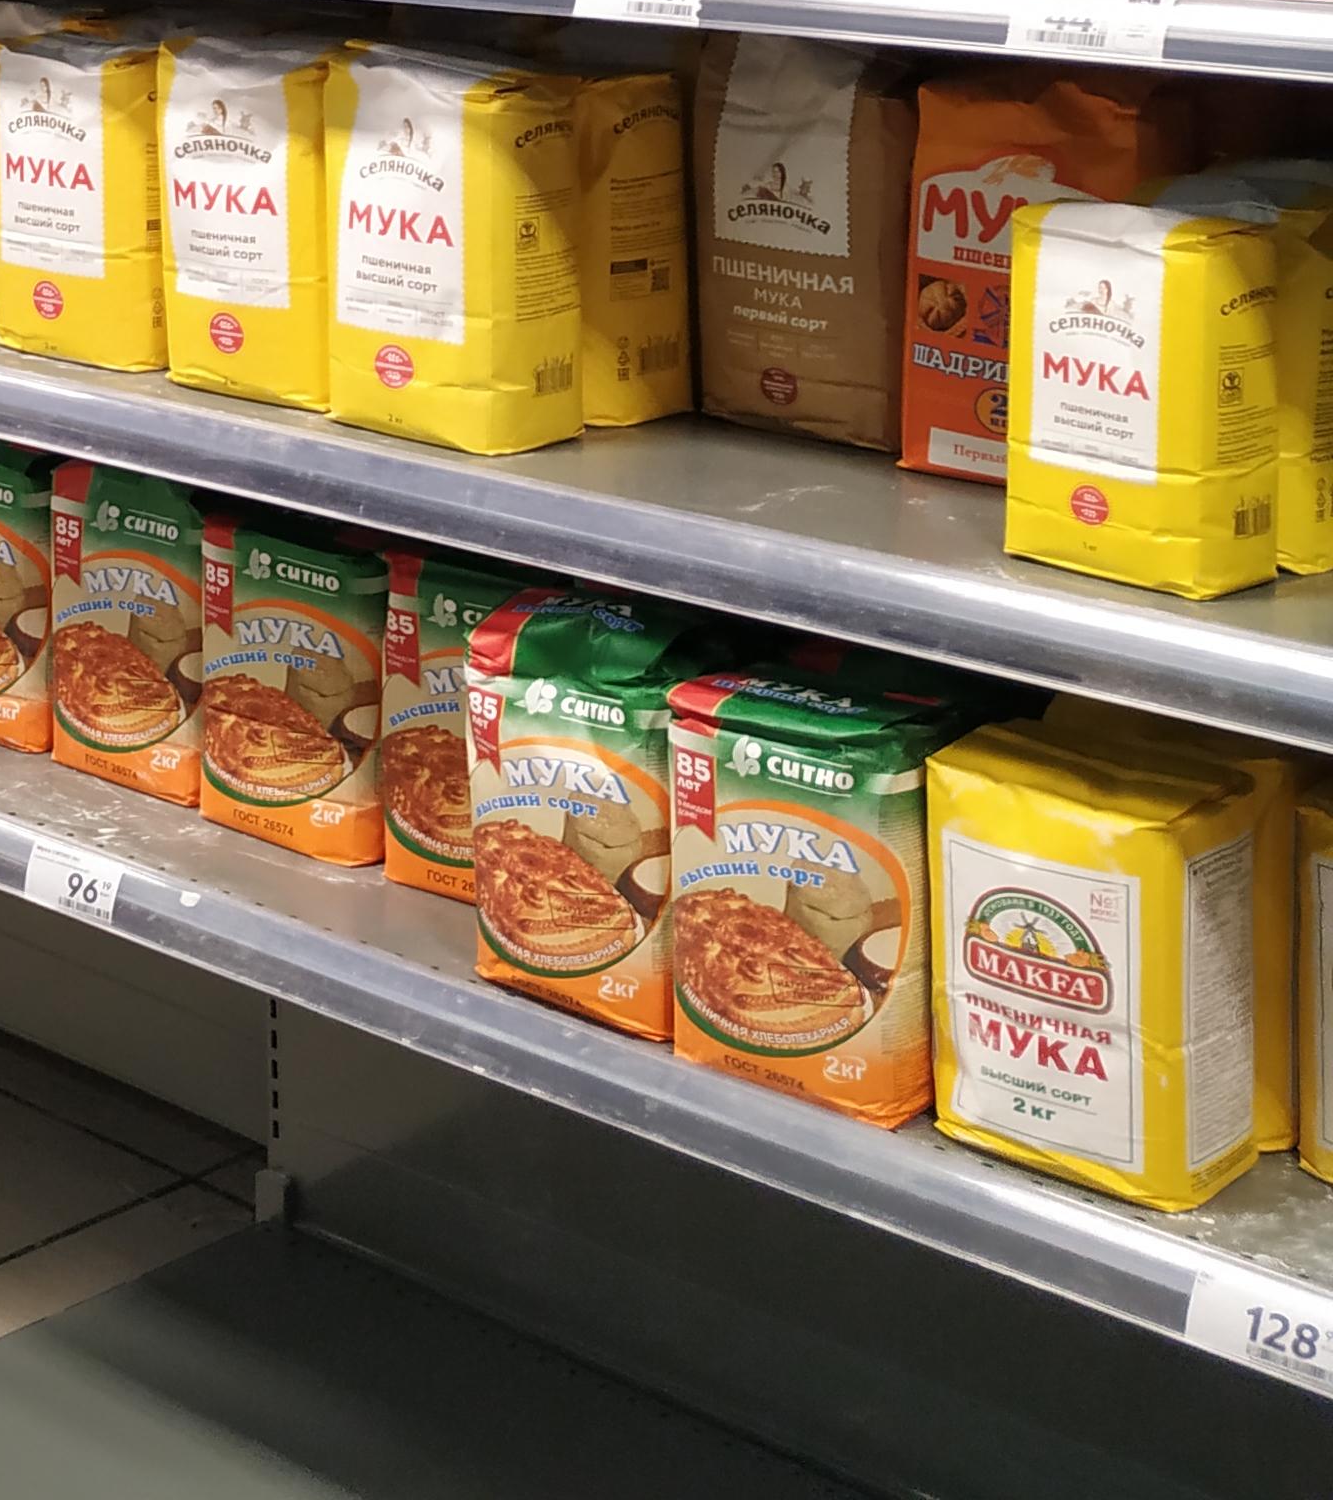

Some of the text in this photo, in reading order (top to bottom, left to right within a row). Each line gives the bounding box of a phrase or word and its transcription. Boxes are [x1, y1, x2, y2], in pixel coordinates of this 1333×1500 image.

[7, 113, 88, 144] селяночка
[173, 137, 273, 164] селяночка
[4, 152, 96, 192] МУКА
[358, 161, 446, 193] селяночка
[17, 200, 75, 219] пшеничная
[172, 177, 279, 217] МУКА
[13, 214, 81, 235] высший сорт
[347, 199, 455, 249] МУКА
[726, 199, 832, 236] селяночка
[190, 228, 257, 246] пшеничная
[188, 243, 264, 263] высший сорт
[360, 254, 433, 277] пшеничная
[355, 269, 439, 294] высший сорт
[712, 255, 855, 296] ПШЕНИЧНАЯ
[753, 287, 804, 311] МУКА
[732, 304, 829, 333] первый сорт
[1048, 313, 1145, 349] селяночка
[1041, 351, 1151, 400] МУКА
[1053, 414, 1135, 441] высший сорт
[1059, 401, 1129, 424] пшеничная
[55, 515, 80, 539] 85
[123, 514, 180, 542] СИТНО
[83, 566, 180, 607] МУКА
[204, 562, 231, 588] 85
[276, 562, 341, 593] СИТНО
[56, 598, 156, 624] высший сорт
[386, 610, 415, 634] 85
[235, 617, 345, 661] МУКА
[204, 648, 317, 675] высший сорт
[389, 697, 462, 728] высший
[469, 690, 499, 721] 85
[560, 696, 626, 726] СИТНО
[501, 755, 632, 806] МУКА
[675, 752, 712, 782] 85
[766, 754, 855, 792] СИТНО
[475, 790, 599, 819] высший сорт
[233, 807, 295, 838] ГОСТ 26574
[717, 821, 861, 876] МУКА
[67, 871, 98, 903] 96
[427, 867, 460, 890] ГОСТ
[680, 859, 826, 890] высший сорт
[976, 946, 1096, 1002] MAKFA
[750, 1016, 852, 1046] ХЛЕБОПЕКАРНАЯ
[964, 991, 1113, 1046] ПШЕНИЧНАЯ
[967, 1011, 1110, 1083] МУКА
[723, 1053, 760, 1081] ГОСТ
[980, 1064, 1093, 1107] ВЫСШИЙ СОРТ
[1012, 1095, 1058, 1122] 2 кг
[1245, 1305, 1321, 1360] 128
